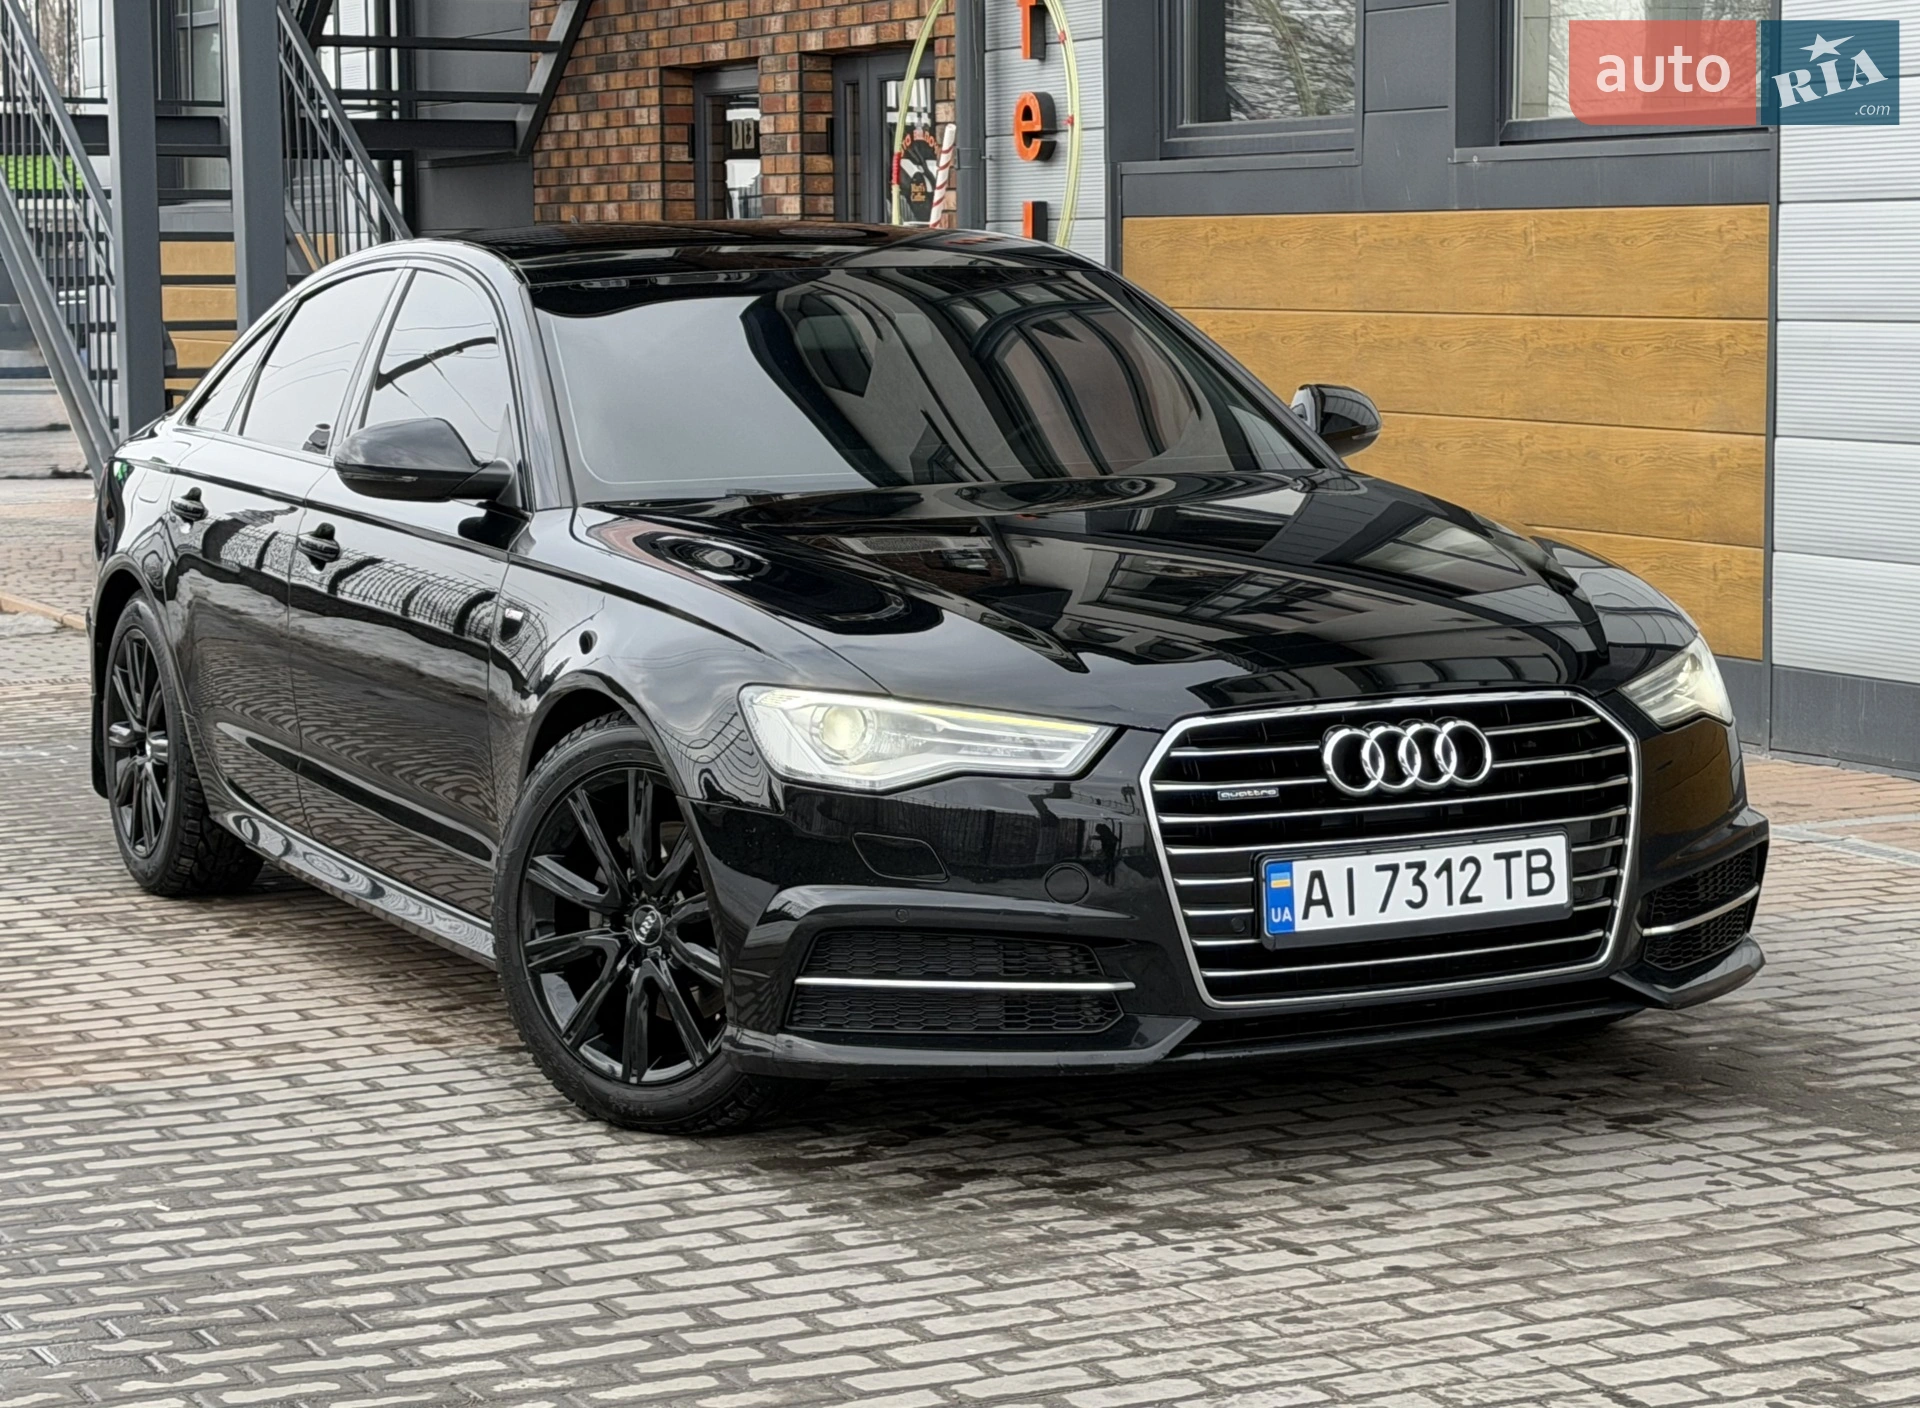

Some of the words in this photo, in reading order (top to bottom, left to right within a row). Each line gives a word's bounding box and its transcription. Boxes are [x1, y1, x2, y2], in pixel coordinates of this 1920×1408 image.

[1220, 789, 1277, 799] quattro
[1374, 855, 1483, 913] 7312
[1493, 847, 1556, 900] TB
[1271, 907, 1293, 924] UA
